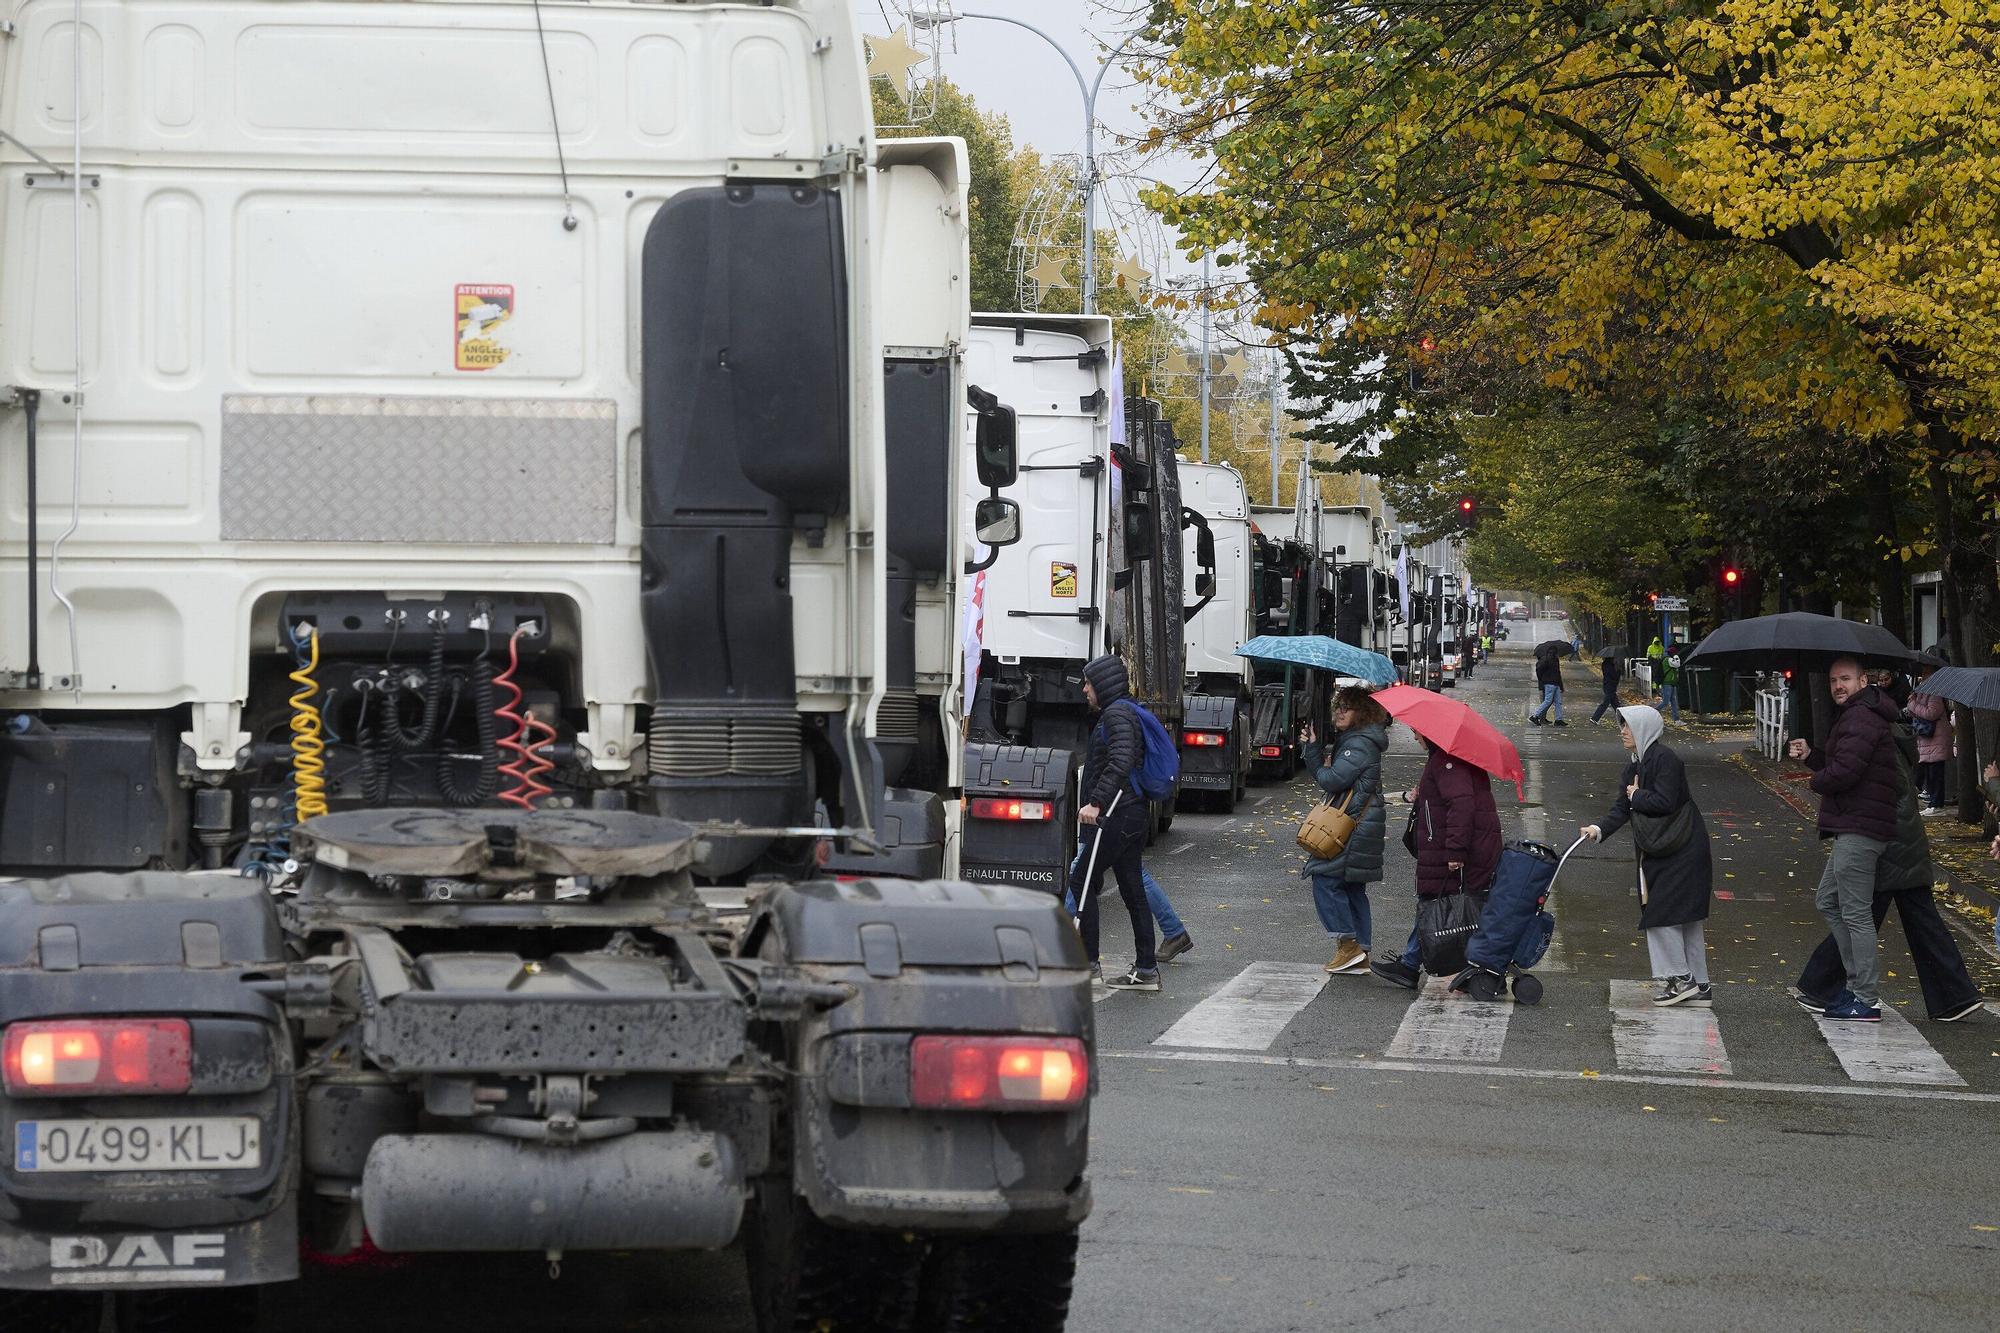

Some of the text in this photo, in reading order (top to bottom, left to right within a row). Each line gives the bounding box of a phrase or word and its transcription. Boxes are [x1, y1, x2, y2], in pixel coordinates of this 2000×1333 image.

[458, 286, 511, 295] ATTENTION
[465, 354, 504, 364] MORTS
[1010, 870, 1053, 882] TRUCKS
[47, 1126, 151, 1164] 0499
[170, 1124, 247, 1162] KLJ
[50, 1233, 226, 1268] DAF
